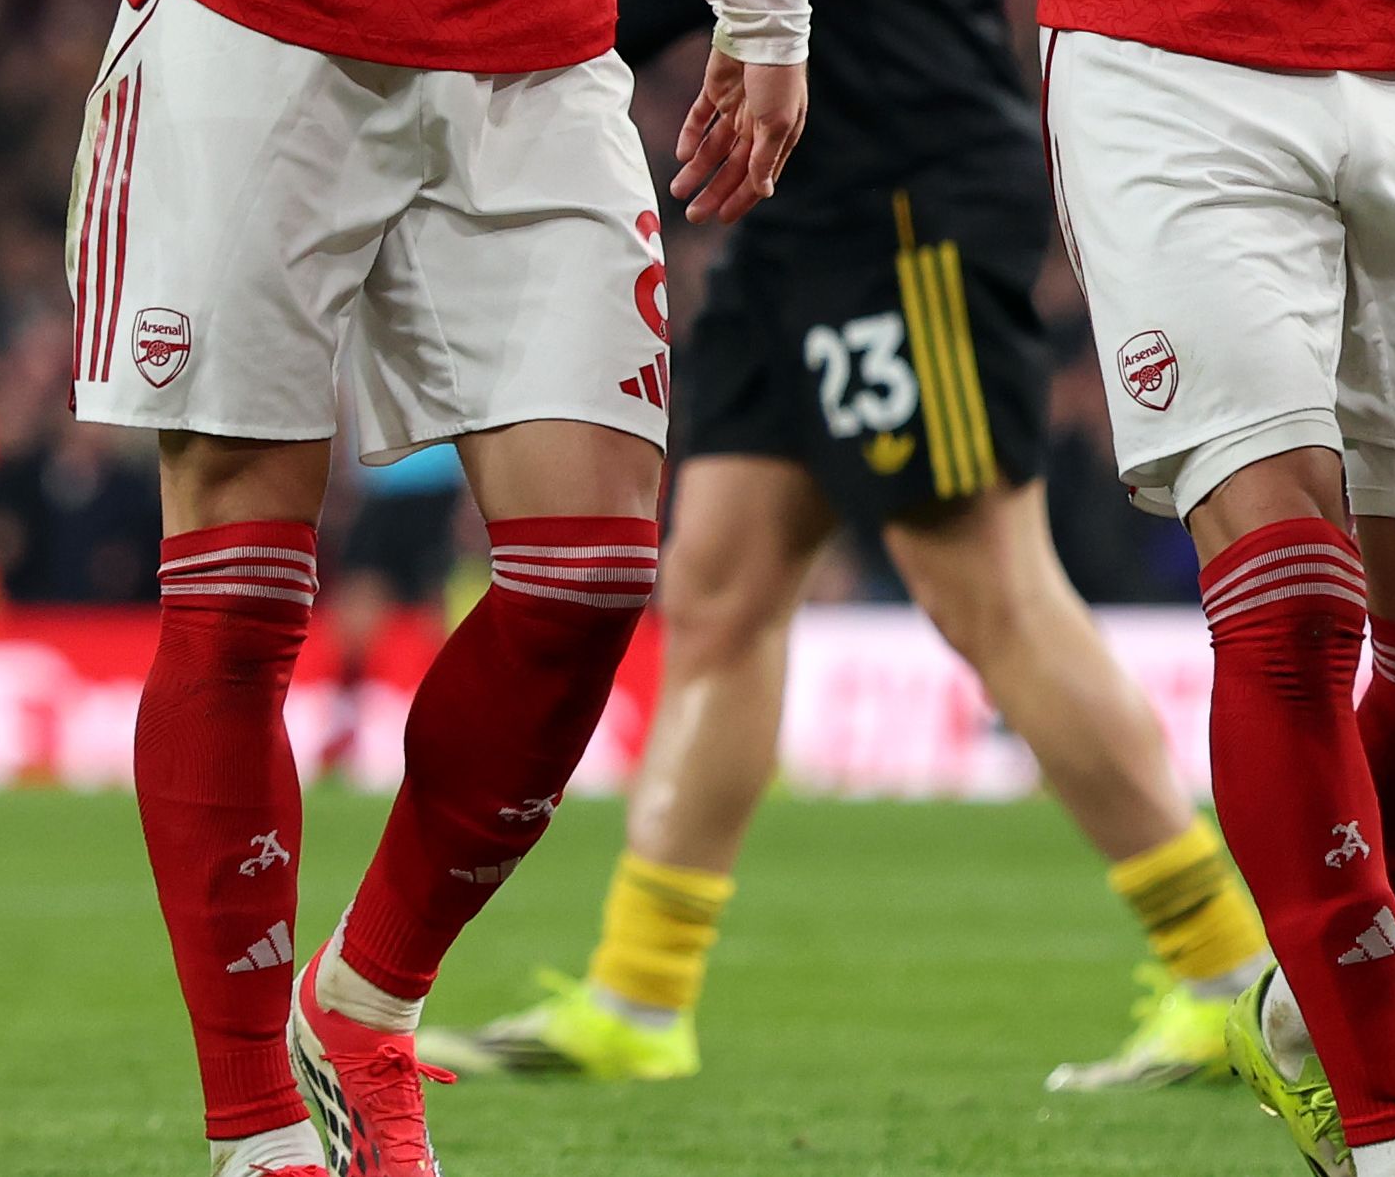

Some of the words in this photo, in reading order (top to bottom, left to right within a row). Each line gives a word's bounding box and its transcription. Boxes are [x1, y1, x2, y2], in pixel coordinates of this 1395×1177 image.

[139, 320, 182, 336] Arsenal
[1124, 341, 1164, 368] Arsenal
[804, 310, 919, 440] 23
